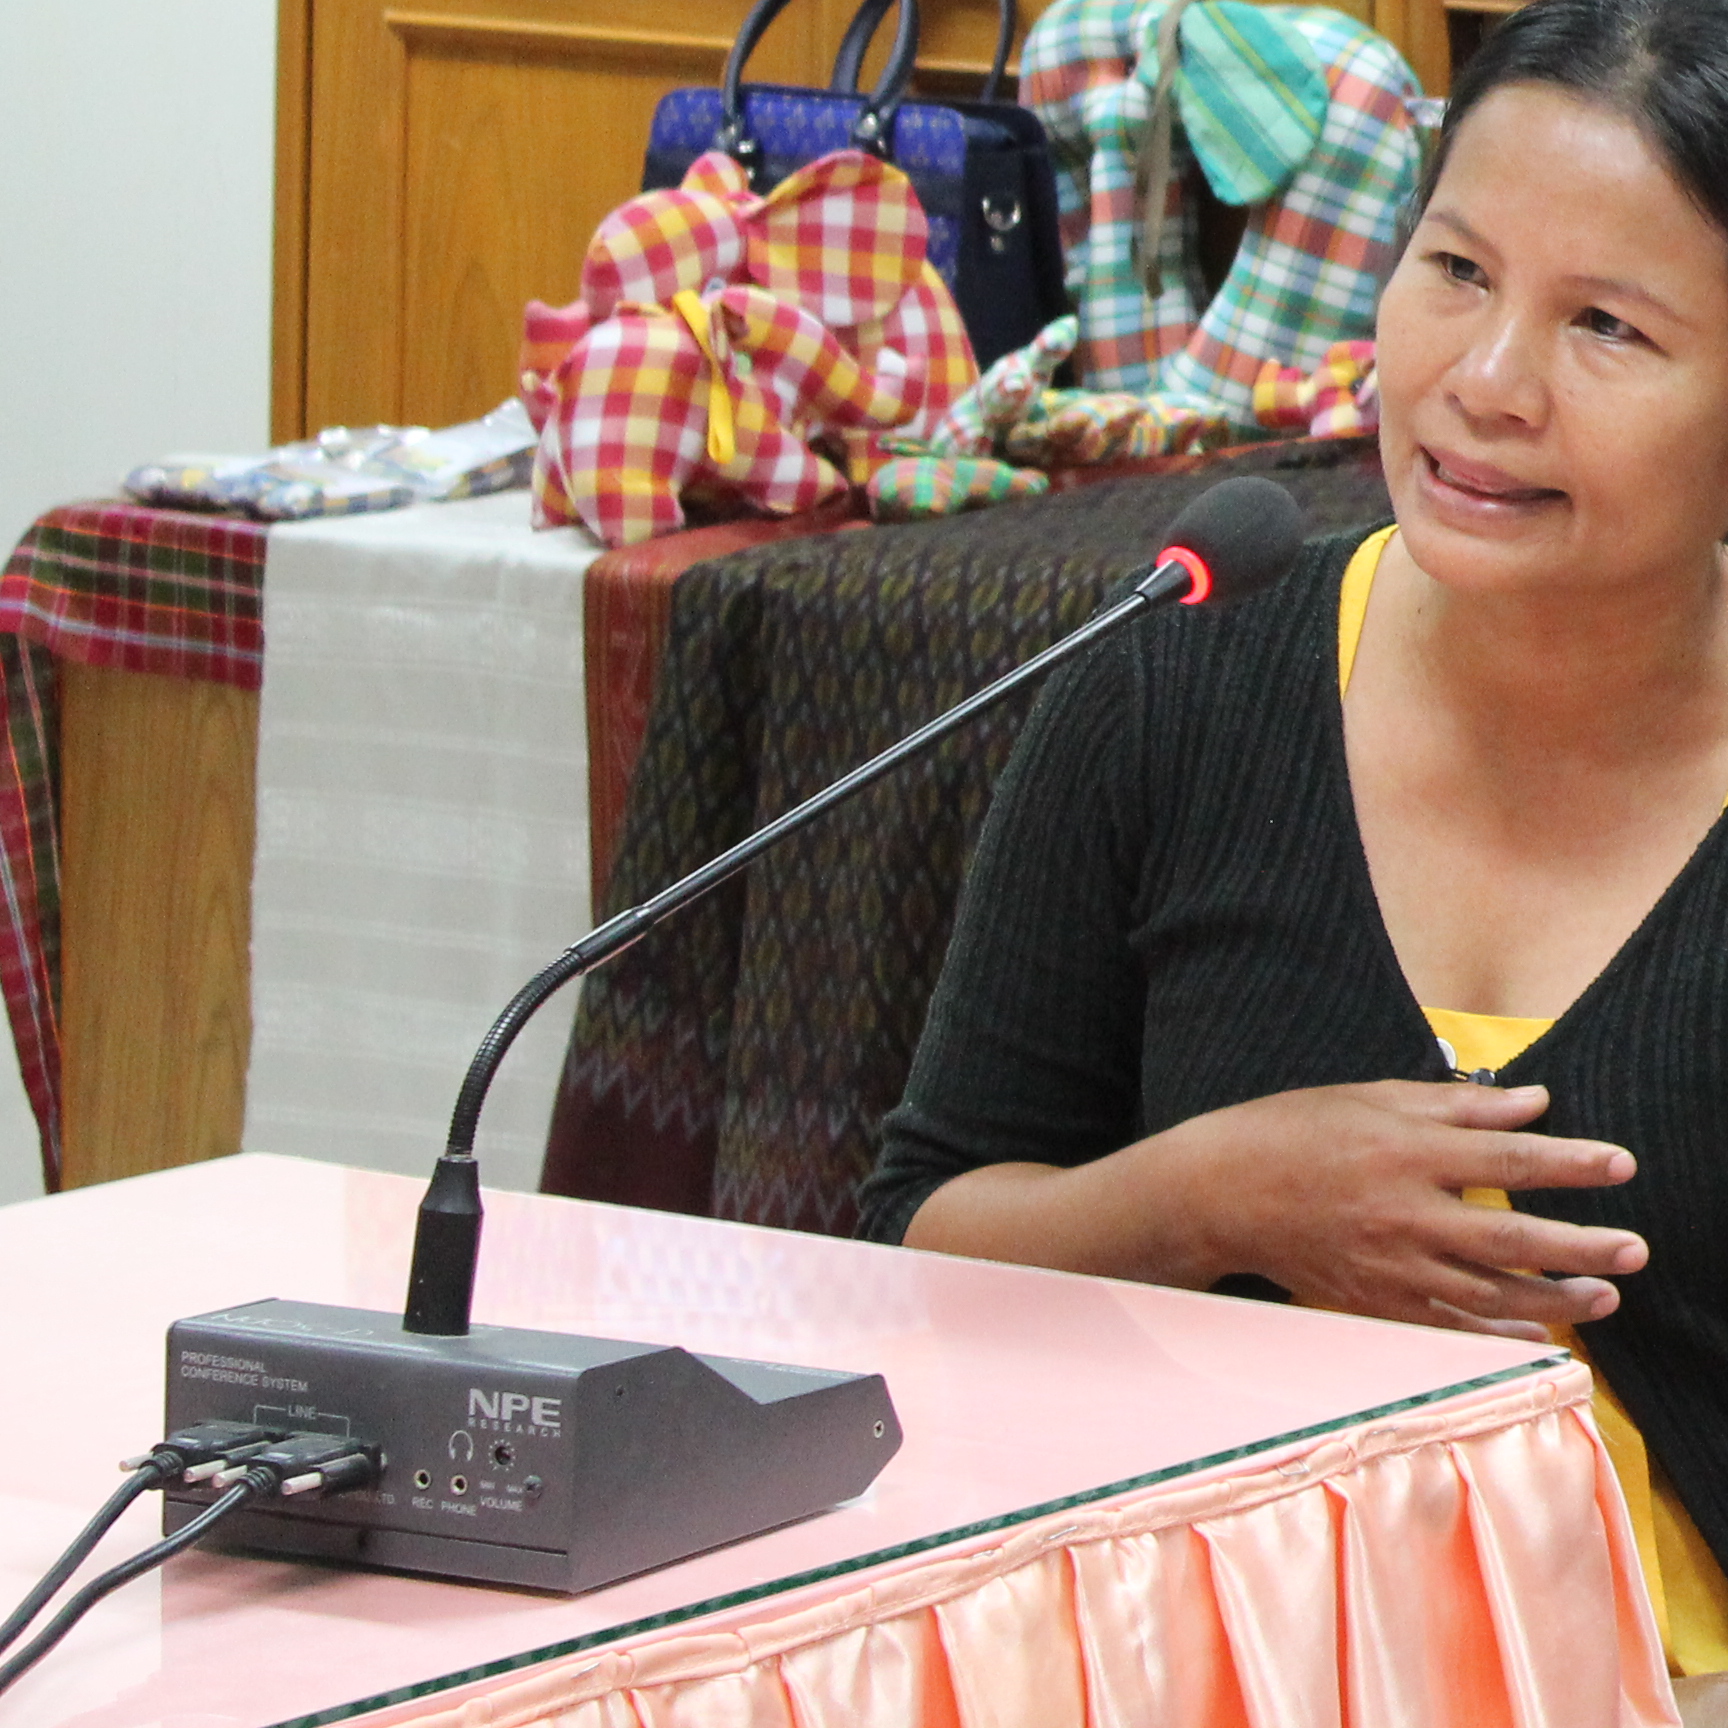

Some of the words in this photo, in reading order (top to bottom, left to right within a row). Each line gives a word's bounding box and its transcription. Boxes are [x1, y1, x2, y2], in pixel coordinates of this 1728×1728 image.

[181, 1350, 267, 1373] PROFESSIONAL
[180, 1365, 259, 1387] CONFERENCE
[261, 1378, 309, 1393] SYSTEM
[287, 1405, 318, 1420] LINE
[468, 1387, 562, 1428] NPE
[467, 1417, 562, 1438] RESEARCH
[411, 1496, 434, 1510] REC
[441, 1501, 477, 1517] PHONE
[479, 1496, 523, 1512] VOLUME
